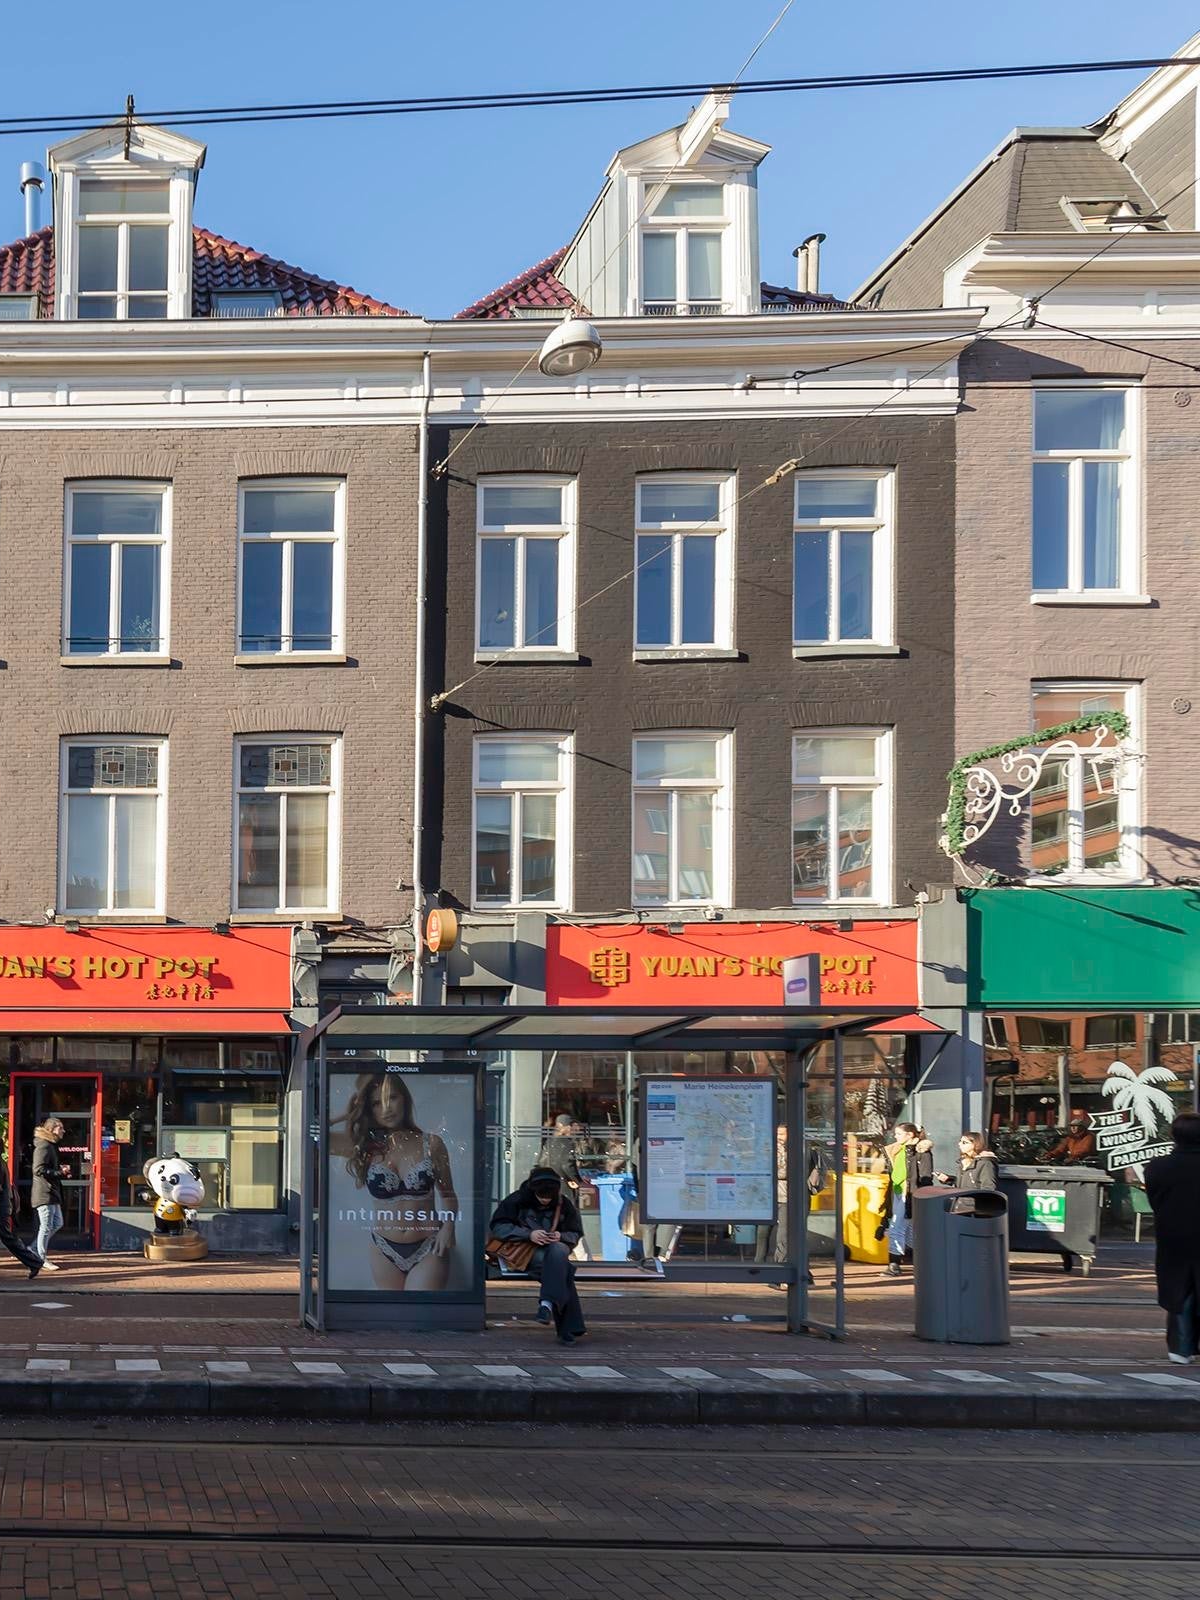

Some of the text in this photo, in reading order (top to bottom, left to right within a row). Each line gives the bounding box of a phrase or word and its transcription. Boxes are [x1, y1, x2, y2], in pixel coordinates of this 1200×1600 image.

[83, 956, 147, 979] HOT
[155, 956, 218, 979] POT
[642, 955, 744, 977] YUAN'S
[819, 955, 874, 976] POT
[385, 1065, 420, 1073] JCDecaux
[1099, 1113, 1124, 1126] THE
[1101, 1130, 1143, 1146] WINGS
[338, 1207, 462, 1222] intimissimi
